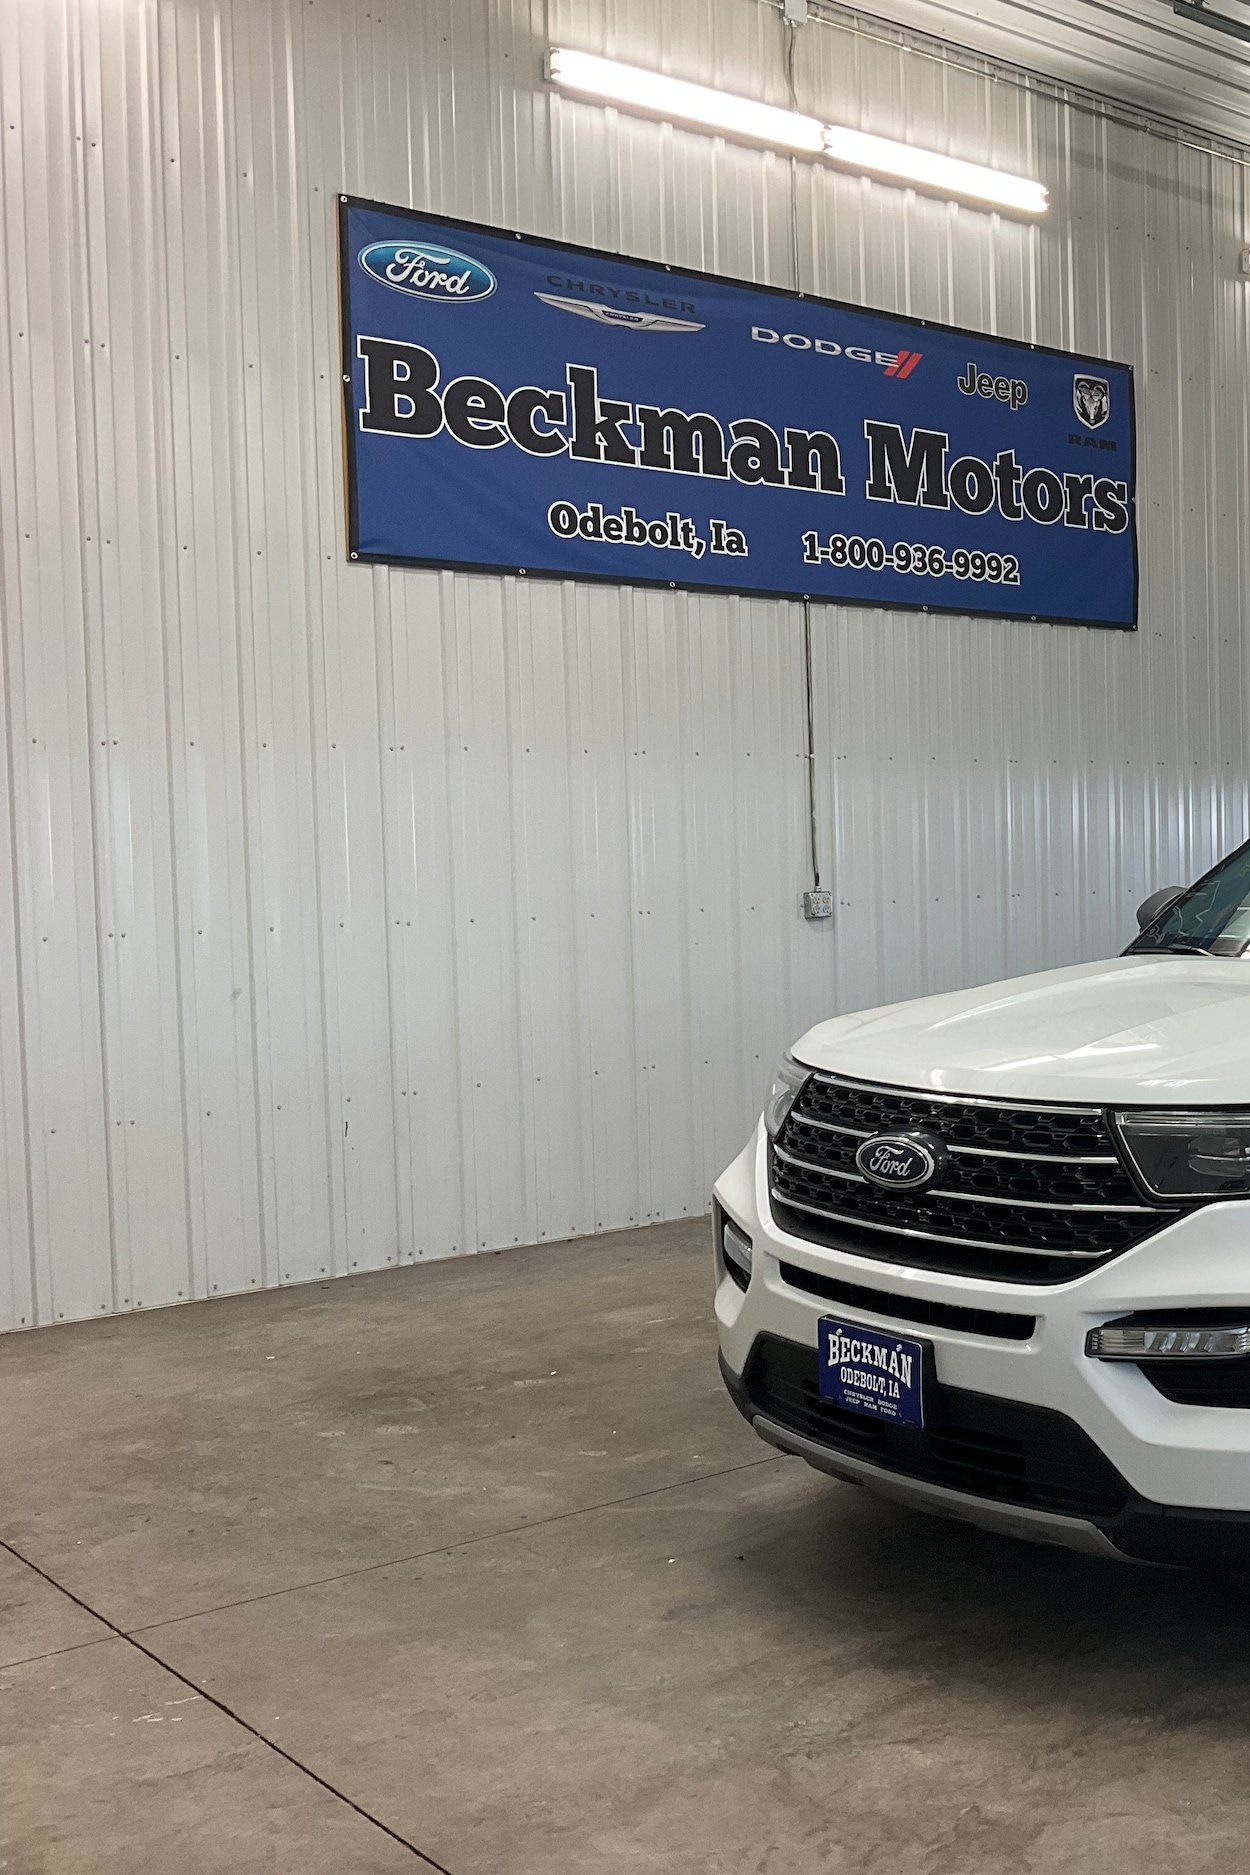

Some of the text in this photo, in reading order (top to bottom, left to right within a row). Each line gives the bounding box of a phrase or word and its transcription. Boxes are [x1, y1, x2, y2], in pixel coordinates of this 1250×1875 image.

[386, 247, 472, 296] Ford
[547, 274, 696, 315] CHRYSLER
[751, 326, 900, 367] DODGE
[957, 362, 1028, 410] Jeep
[357, 334, 1130, 535] Beckman Motors
[1068, 433, 1117, 452] RAM
[801, 530, 1021, 586] 1-800-936-9992
[869, 1145, 913, 1176] Ford
[828, 1334, 912, 1388] BECKMAN
[840, 1366, 900, 1398] ODEBOLT, IA
